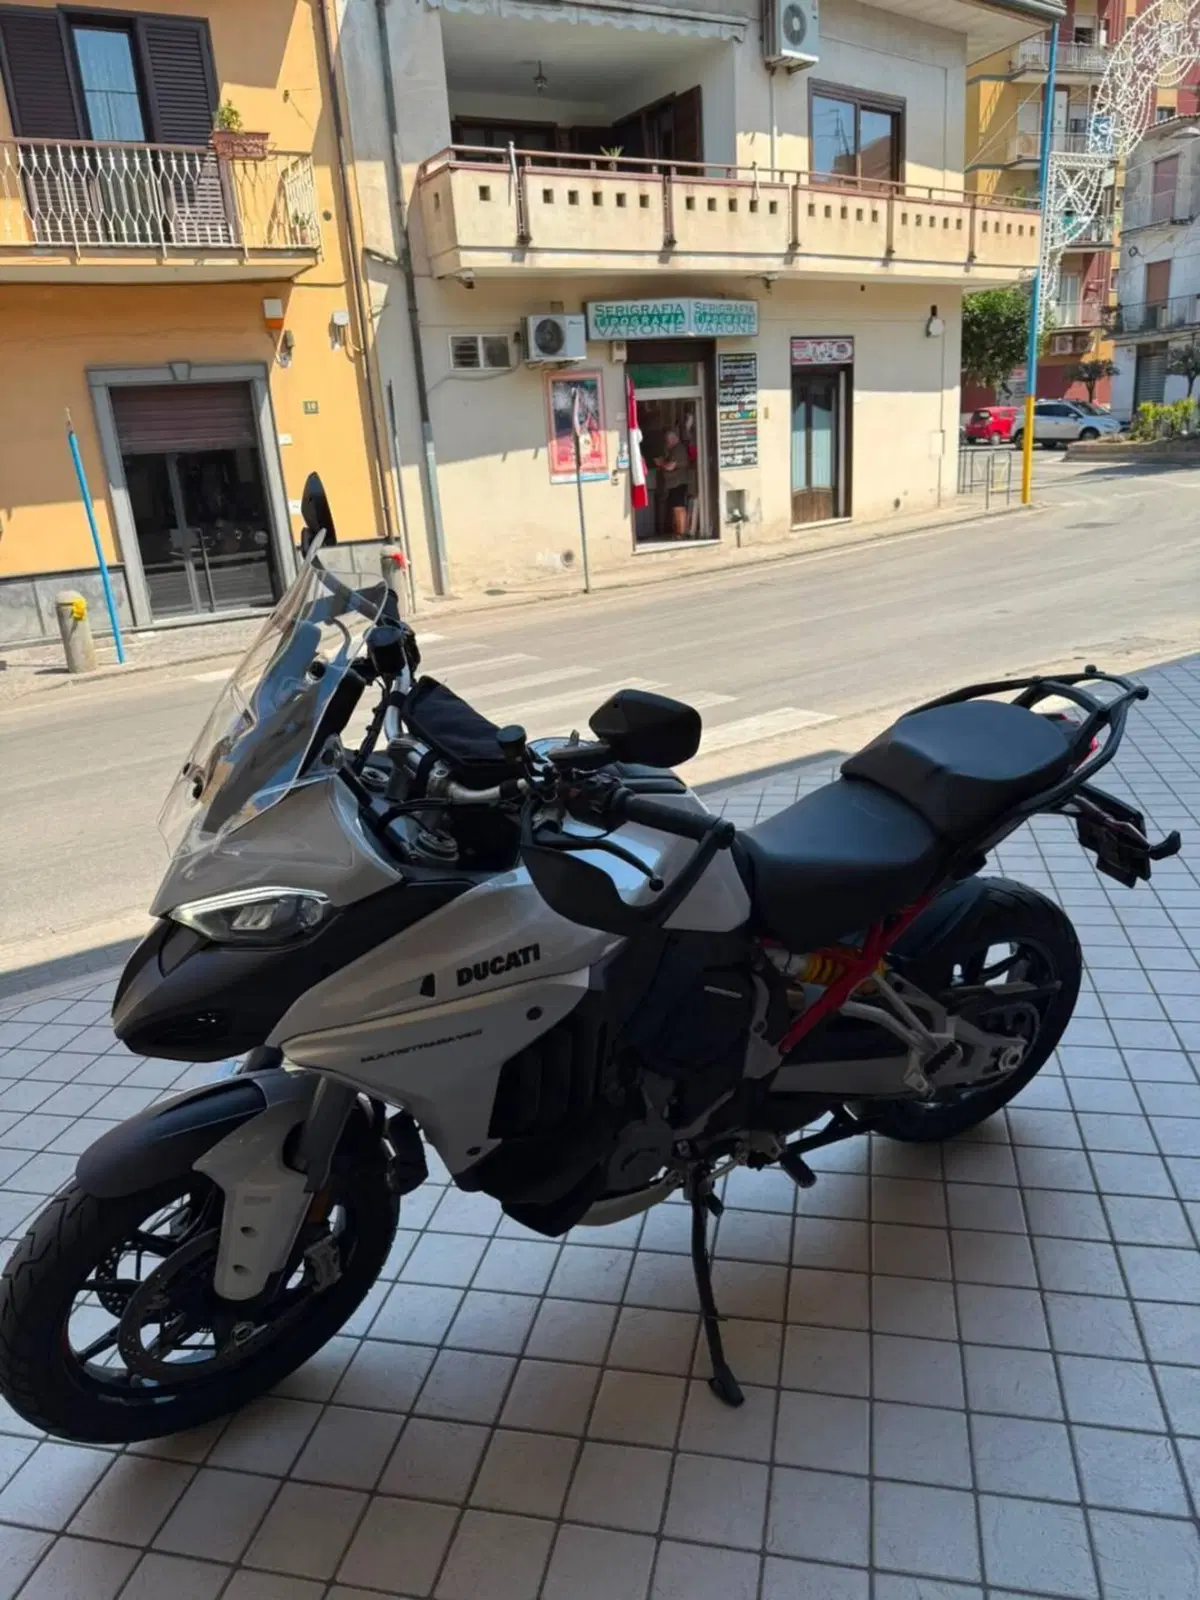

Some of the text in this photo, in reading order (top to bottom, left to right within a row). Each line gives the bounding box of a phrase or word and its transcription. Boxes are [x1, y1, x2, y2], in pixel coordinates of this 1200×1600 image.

[594, 303, 685, 316] SERIGRAFIA
[694, 302, 754, 314] SERIGRAFIA
[595, 314, 685, 326] TIPOGRAFIA
[594, 323, 686, 337] VARONE
[694, 323, 757, 333] VARONE
[456, 942, 541, 988] DUCATI
